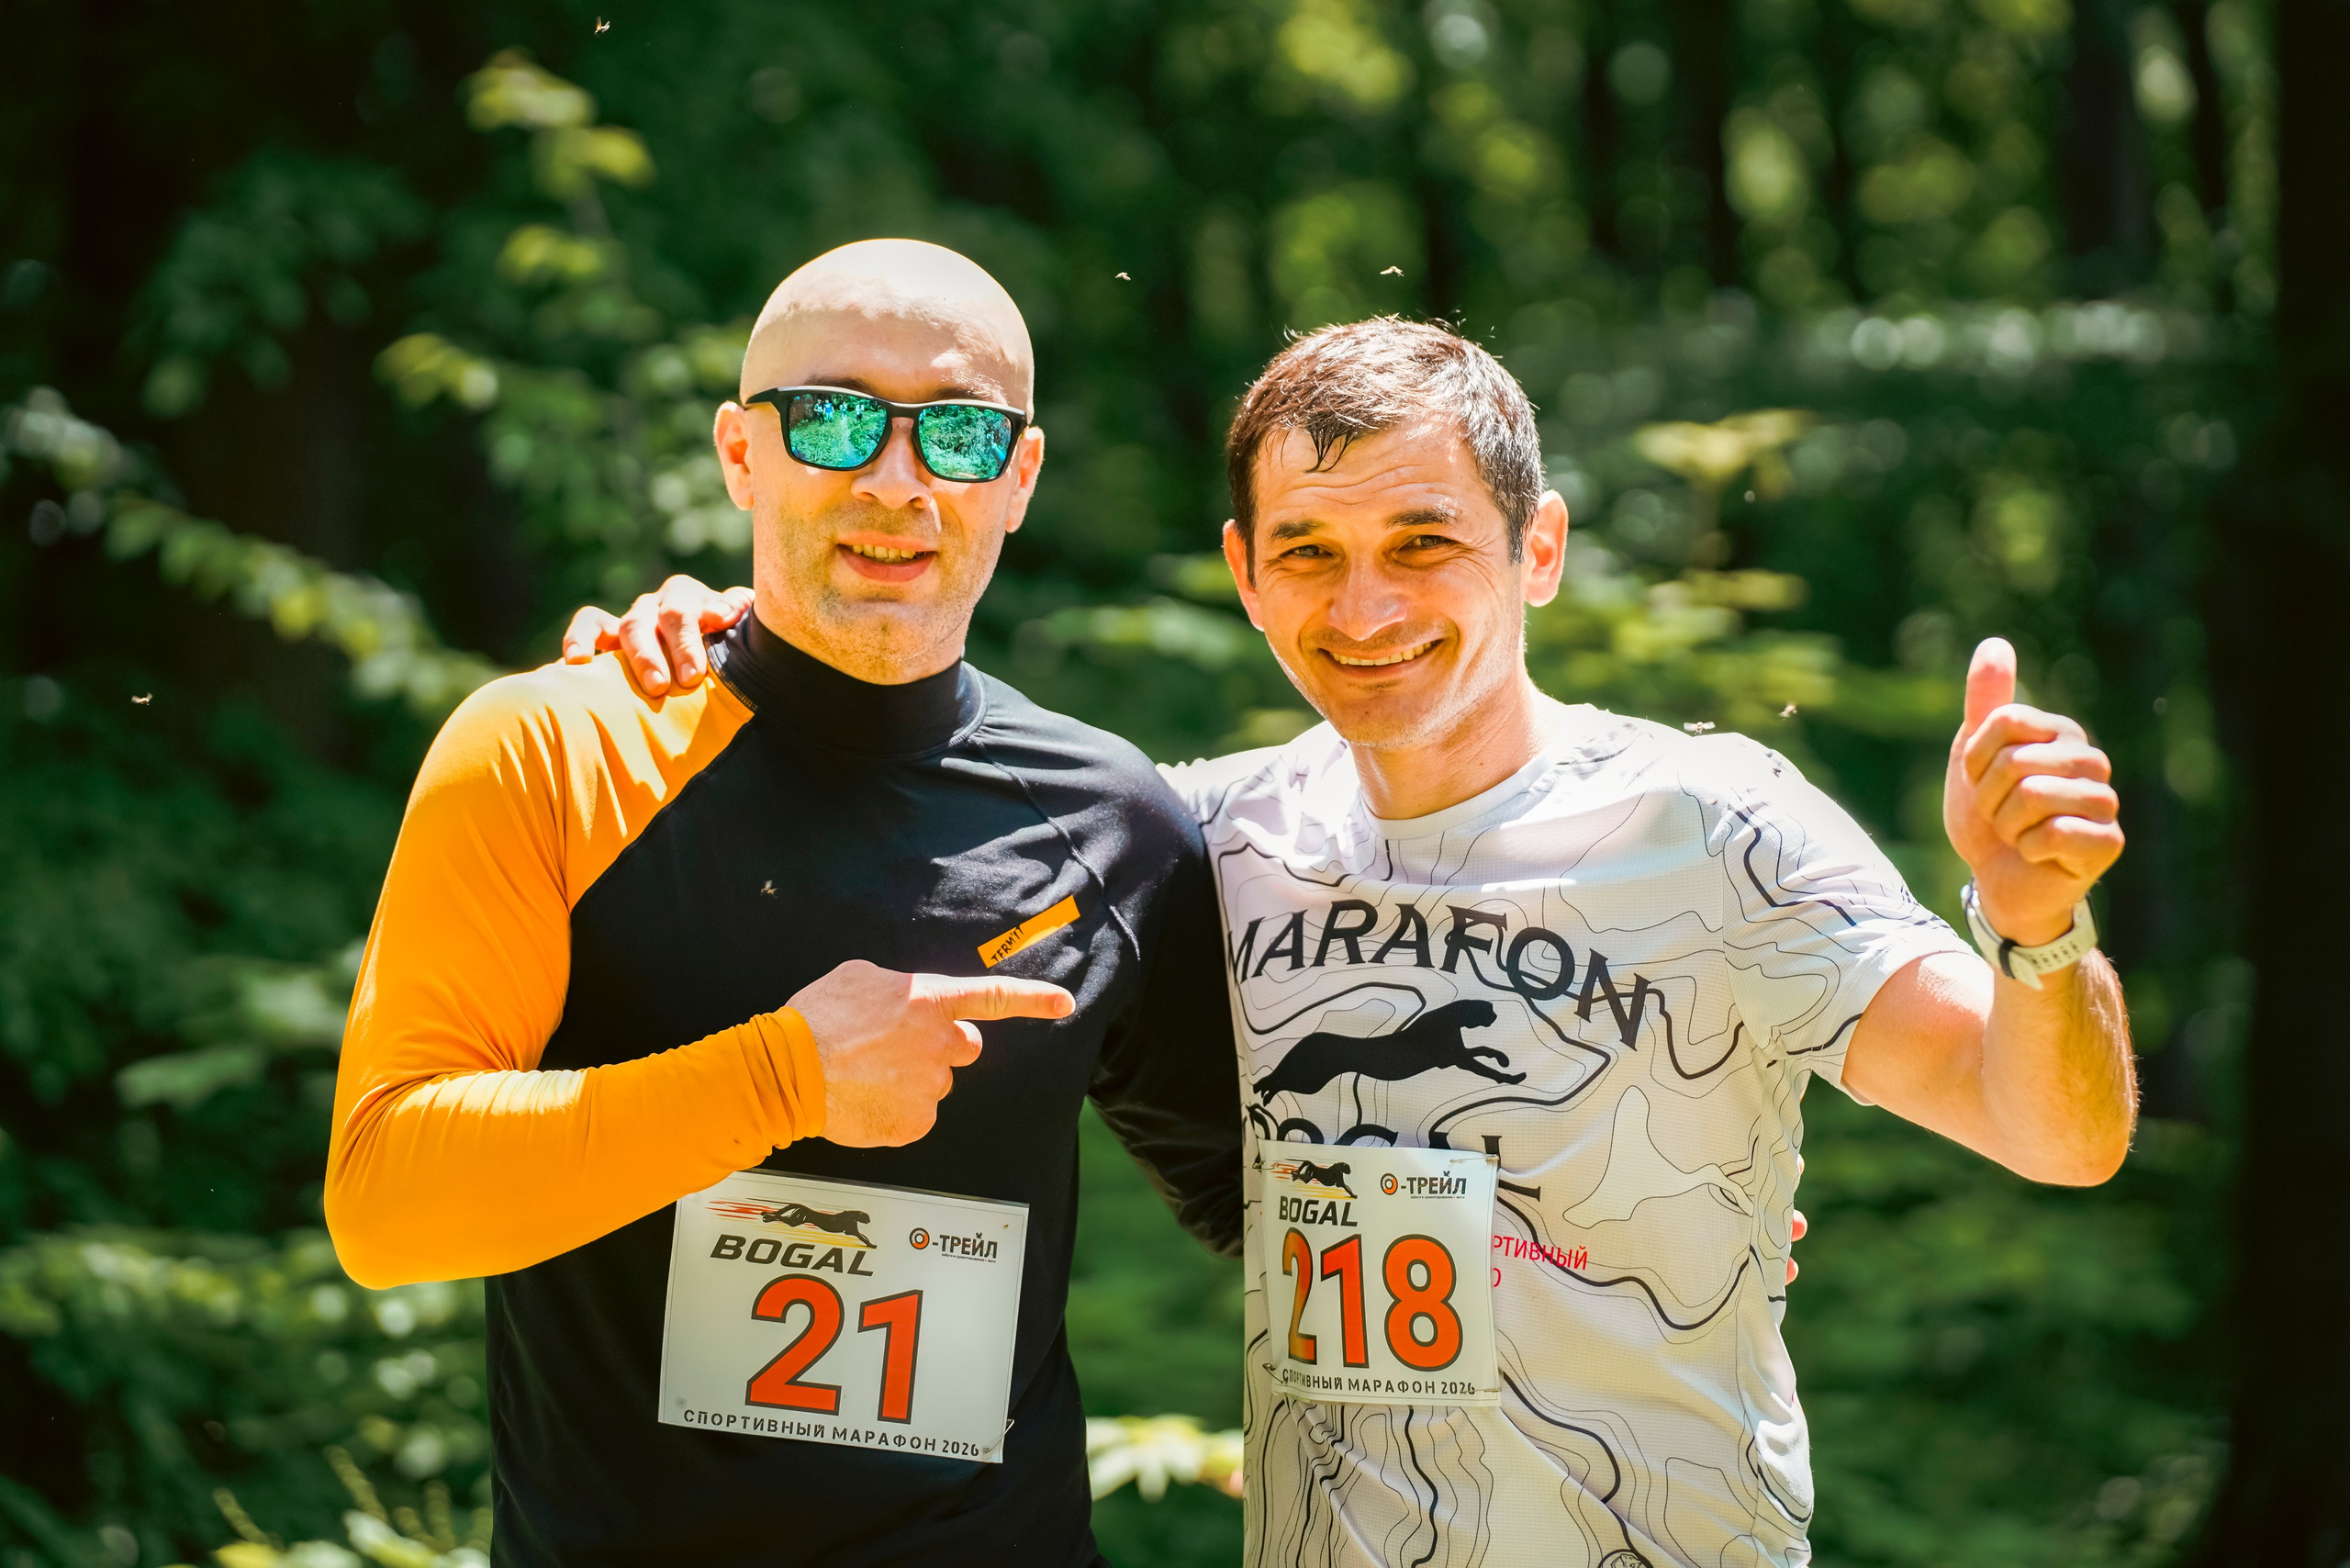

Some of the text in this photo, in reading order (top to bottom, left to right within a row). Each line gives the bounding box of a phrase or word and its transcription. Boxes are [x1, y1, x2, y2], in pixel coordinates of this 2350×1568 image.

[1227, 900, 1651, 1051] MARAFON
[1279, 1195, 1359, 1227] BOGAL
[710, 1233, 875, 1277] BOGAL
[1494, 1235, 1588, 1271] РТИВНЫЙ
[1281, 1226, 1464, 1372] 218
[744, 1272, 924, 1426] 21
[1282, 1368, 1476, 1395] СПОРТИВНЫЙ МАРАФОН 2026
[683, 1409, 980, 1457] СПОРТИВНЫЙ МАРАФОН 2026
